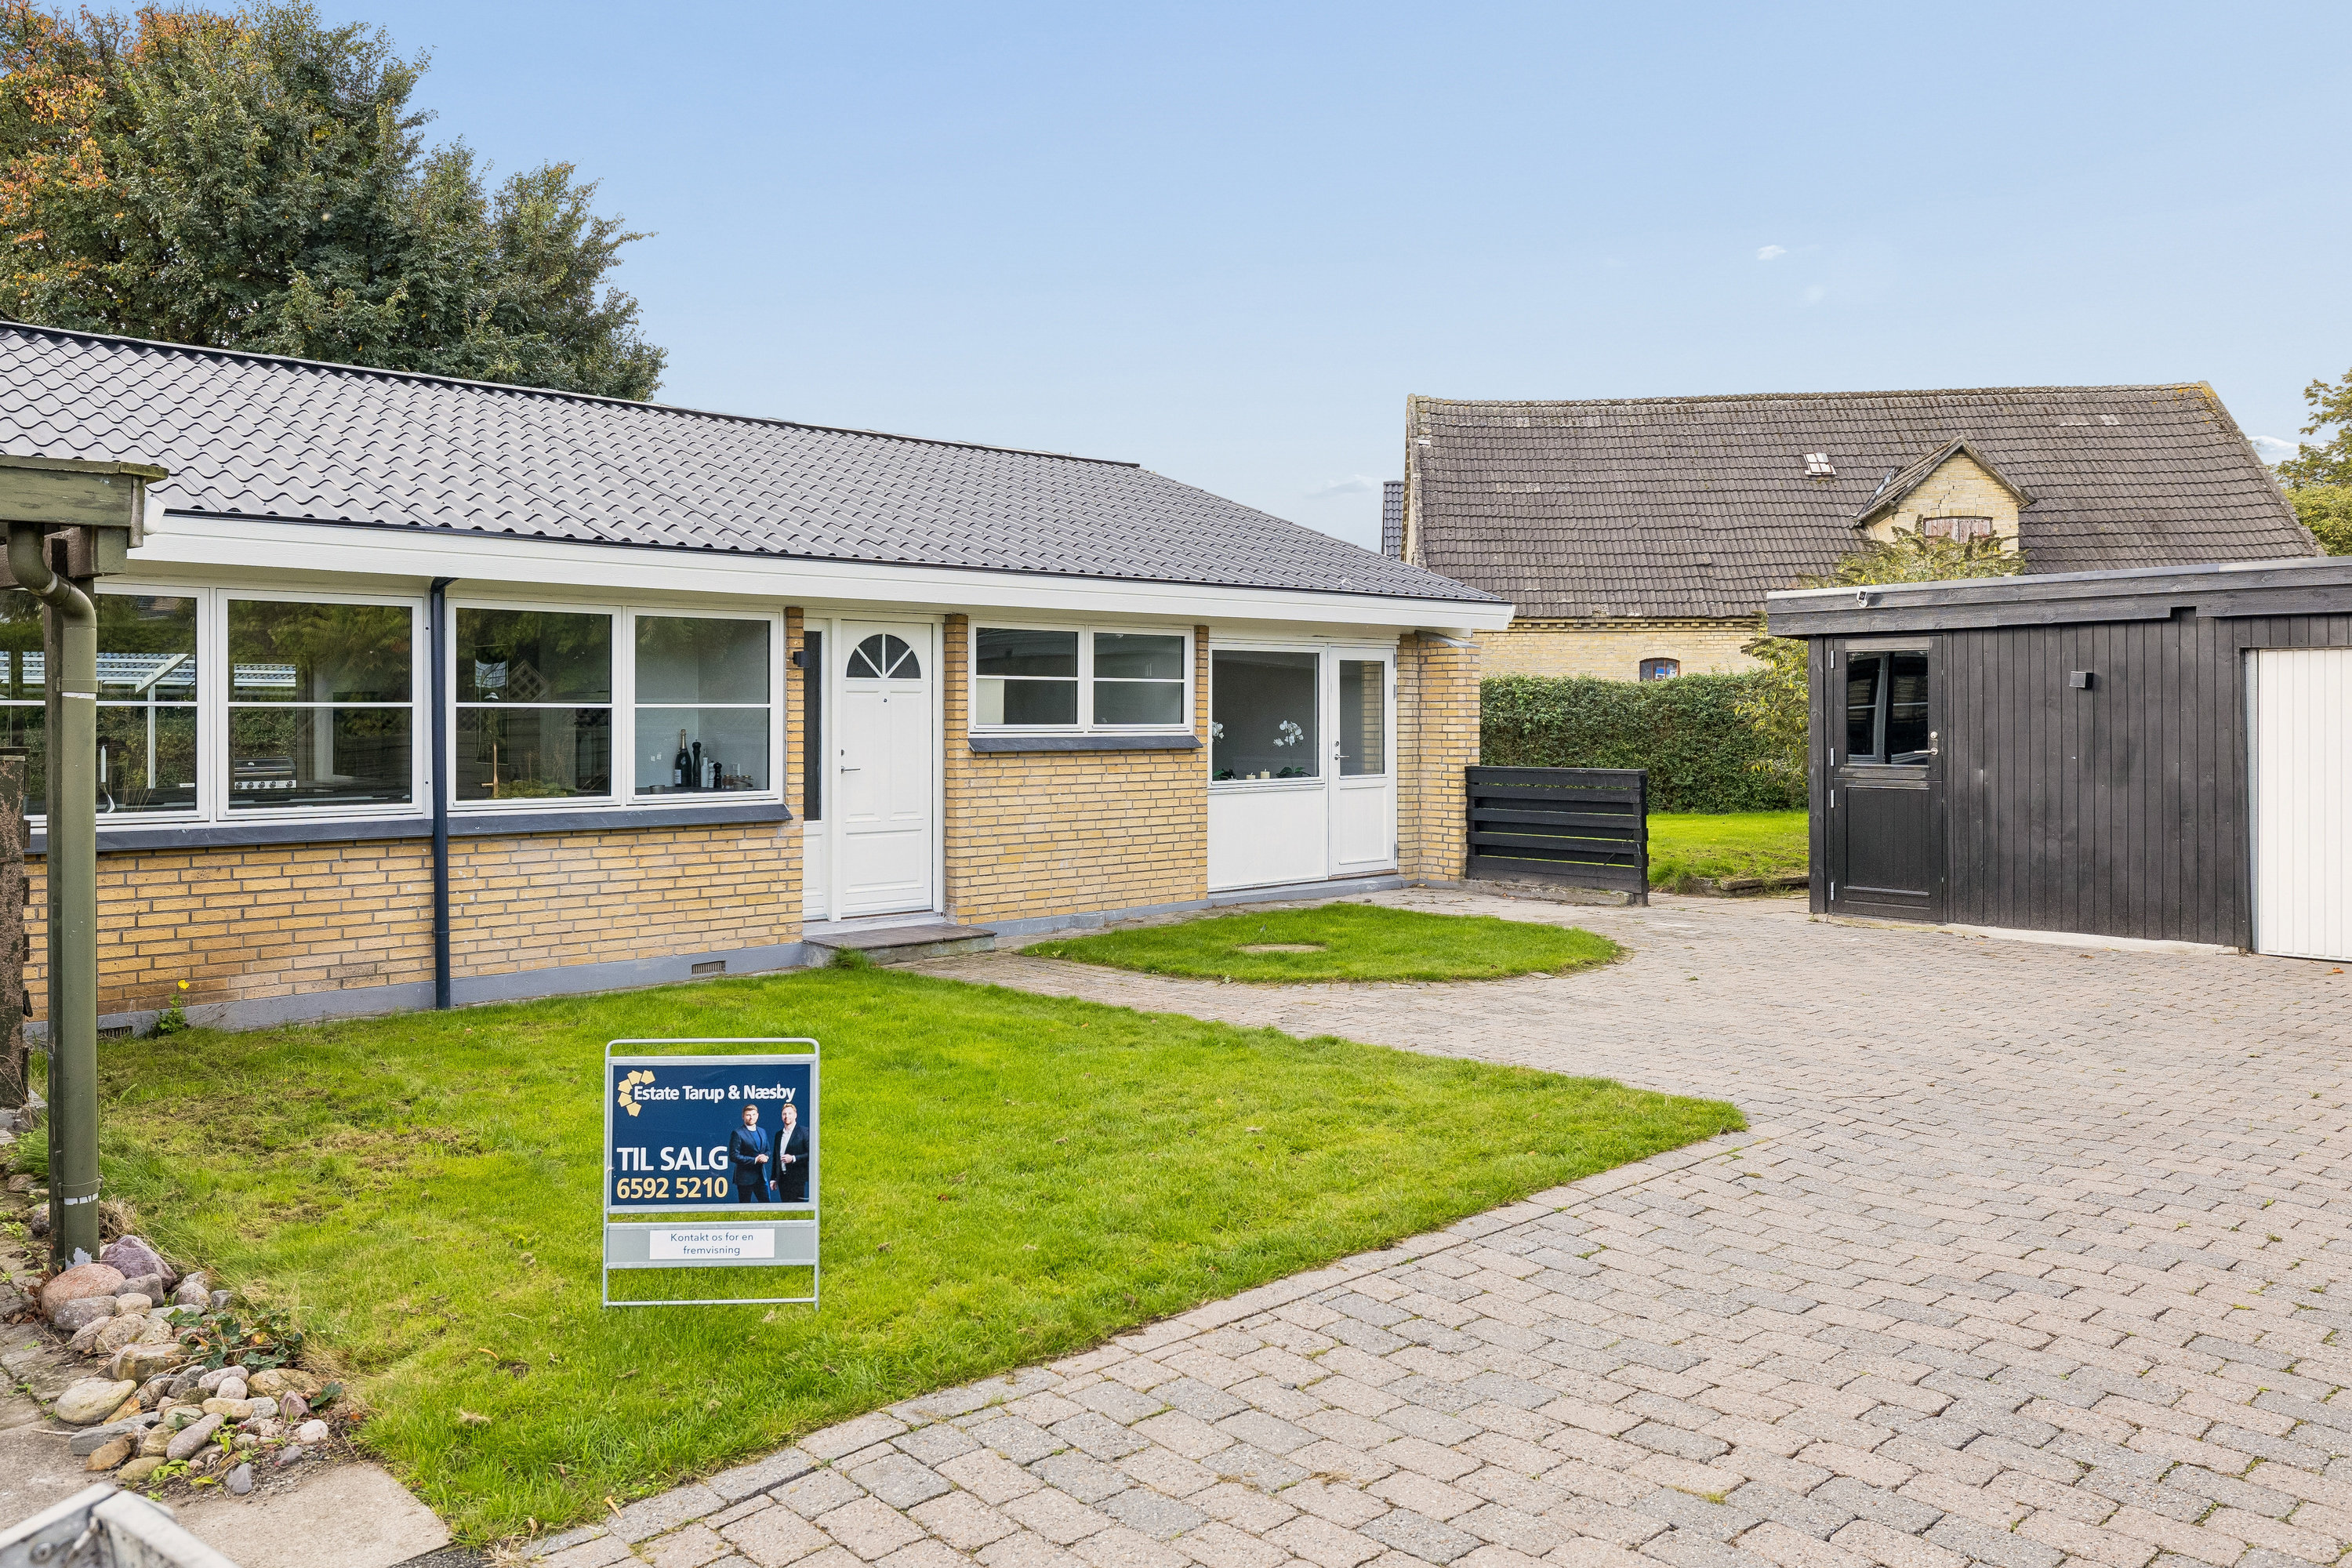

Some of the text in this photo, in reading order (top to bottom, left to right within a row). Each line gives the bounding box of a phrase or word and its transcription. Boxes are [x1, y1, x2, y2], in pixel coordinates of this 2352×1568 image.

[634, 1083, 796, 1103] Estate Tarup & Næsby
[616, 1146, 728, 1171] TIL SALG
[616, 1177, 728, 1199] 6592 5210
[670, 1232, 710, 1242] Kontakt
[725, 1232, 739, 1241] for
[683, 1245, 741, 1256] fremvisning
